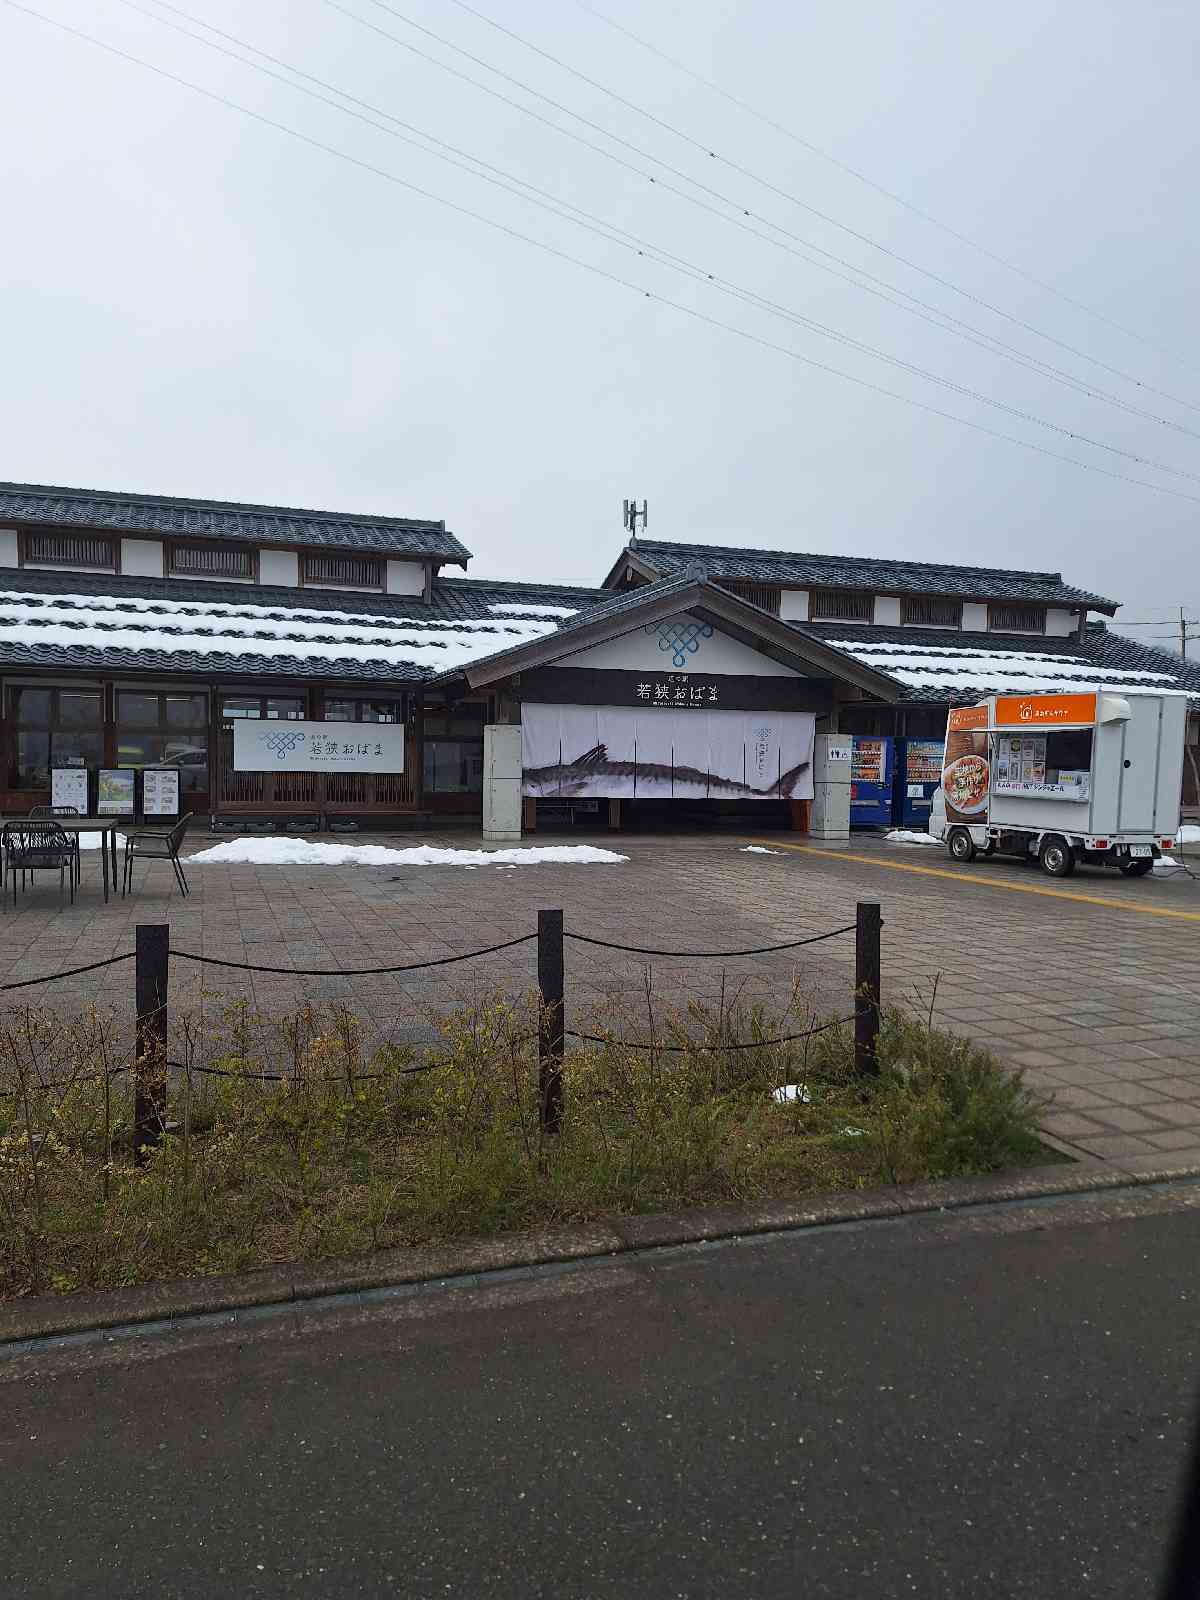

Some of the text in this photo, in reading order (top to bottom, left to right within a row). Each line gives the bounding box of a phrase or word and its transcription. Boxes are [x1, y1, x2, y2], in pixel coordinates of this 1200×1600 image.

[636, 682, 718, 701] 若狭おばま
[310, 741, 385, 756] 若狭おばま
